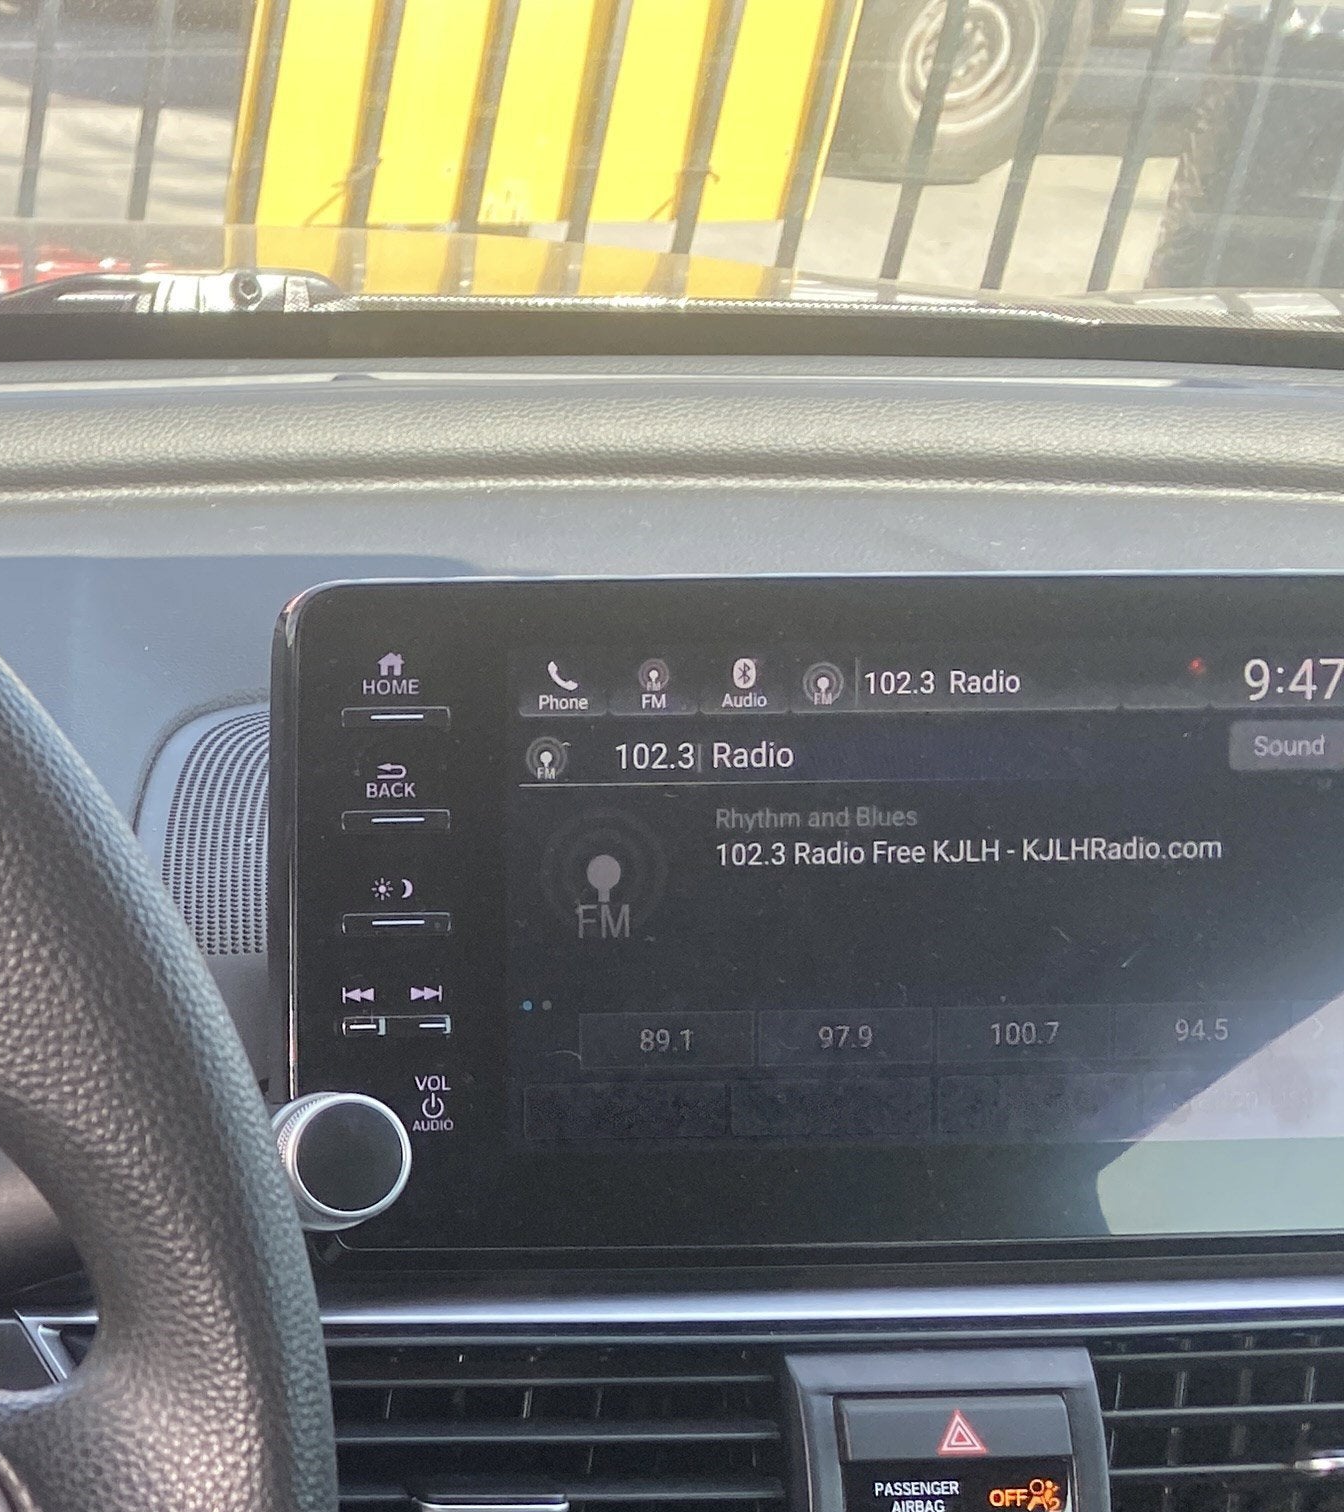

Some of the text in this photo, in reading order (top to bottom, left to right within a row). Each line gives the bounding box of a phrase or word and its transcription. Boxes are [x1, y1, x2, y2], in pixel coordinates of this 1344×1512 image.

[363, 677, 419, 696] HOME
[864, 669, 1021, 696] 102.3 Radio
[1244, 658, 1344, 701] 9:47
[539, 693, 589, 711] Phone
[642, 693, 667, 709] FM
[722, 692, 768, 709] Audio
[615, 741, 795, 770] 102.3 Radio
[1254, 734, 1326, 757] Sound
[537, 766, 556, 780] FM
[366, 782, 416, 799] BACK
[715, 806, 918, 832] Rhythm and Blues
[716, 842, 786, 868] 102.3
[794, 842, 865, 866] Radio
[872, 841, 926, 864] Free
[933, 840, 1000, 864] KJLH
[1023, 838, 1223, 862] KJLHRadio.com
[577, 905, 631, 938] FM
[639, 1028, 693, 1052] 89.1
[818, 1025, 874, 1049] 97.9
[990, 1021, 1060, 1046] 100.7
[1174, 1018, 1229, 1042] 94.5
[415, 1075, 451, 1091] VOL
[413, 1119, 454, 1131] AUDIO
[874, 1480, 960, 1496] PASSENGER
[989, 1489, 1027, 1507] OFF
